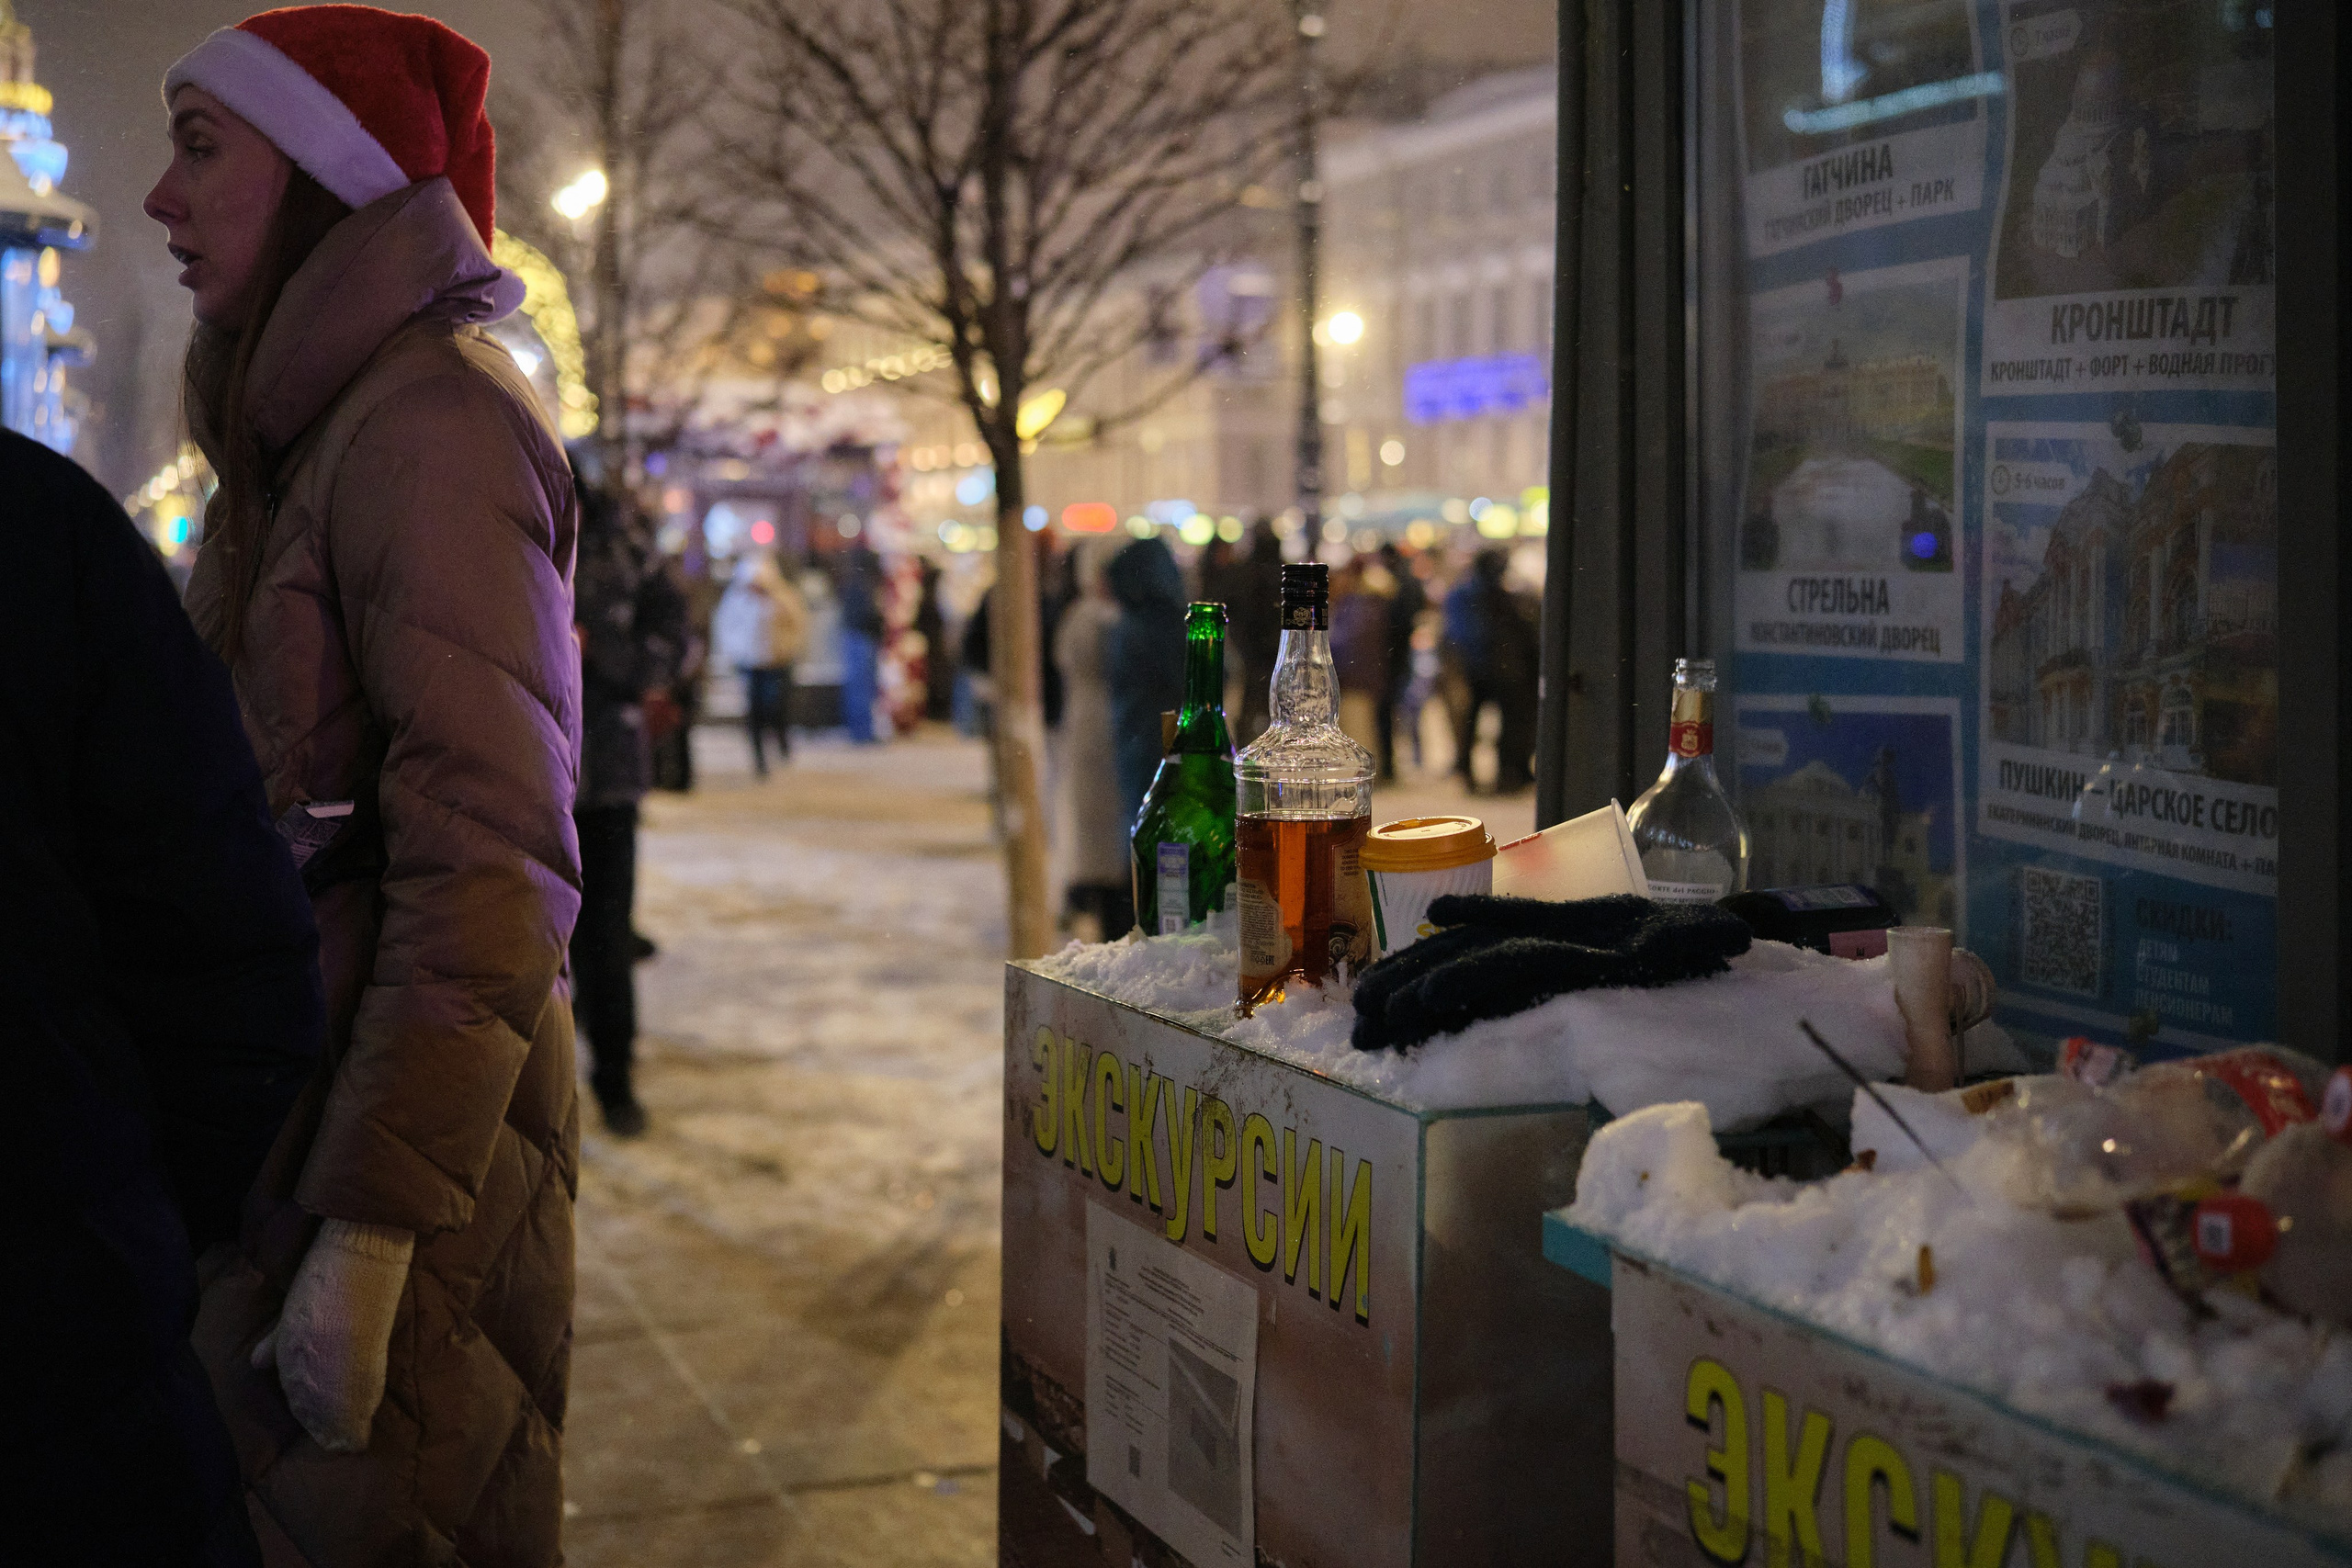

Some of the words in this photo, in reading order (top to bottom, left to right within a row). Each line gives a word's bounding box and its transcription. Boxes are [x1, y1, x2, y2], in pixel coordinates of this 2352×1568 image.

[1803, 143, 1894, 200] ГАТЧИНА
[1834, 187, 1893, 227] ДВОРЕЦ
[1910, 177, 1955, 209] ПАРК
[2051, 295, 2240, 346] КРОНШТАДТ
[1990, 356, 2073, 383] КРОНШТАДТ
[2075, 362, 2086, 378] +
[2089, 354, 2129, 378] ФОРТ
[2133, 359, 2145, 375] +
[2148, 352, 2215, 378] ВОДНАЯ
[1788, 578, 1890, 615] СТРЕЛЬНА
[1880, 626, 1940, 658] ДВОРЕЦ
[1998, 759, 2086, 804] ПУШКИН
[2109, 778, 2204, 829] ЦАРСКОЕ
[2211, 797, 2278, 840] СЕЛО
[2124, 831, 2179, 860] ЯНТАРНАЯ
[2181, 842, 2238, 872] КОМНАТА
[1031, 1025, 1373, 1328] ЭКСКУРСИИ
